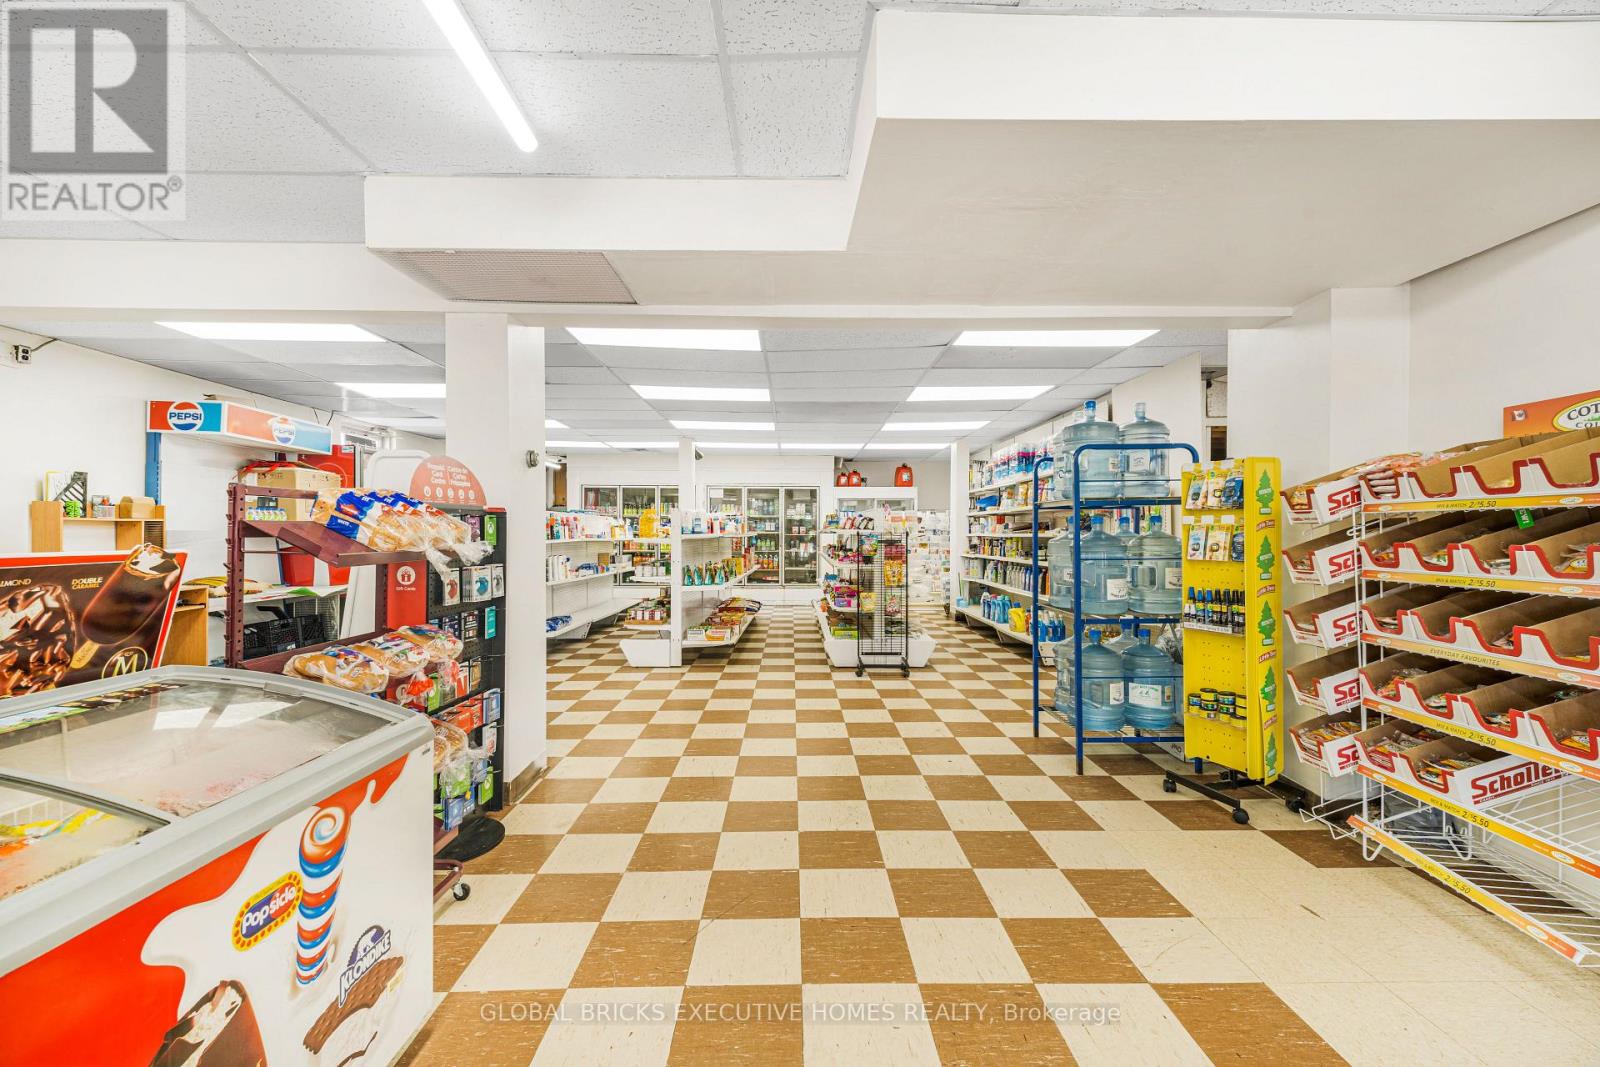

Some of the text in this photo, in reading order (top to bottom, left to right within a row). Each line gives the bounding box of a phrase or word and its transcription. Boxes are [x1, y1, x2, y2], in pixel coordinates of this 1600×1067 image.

[169, 411, 202, 421] PEPSI
[0, 577, 104, 588] LMOND DOUBLE
[1430, 648, 1501, 666] EVERYDAY FAVOURITES
[242, 884, 297, 935] Popsicle
[339, 929, 392, 1007] KLONDIKE
